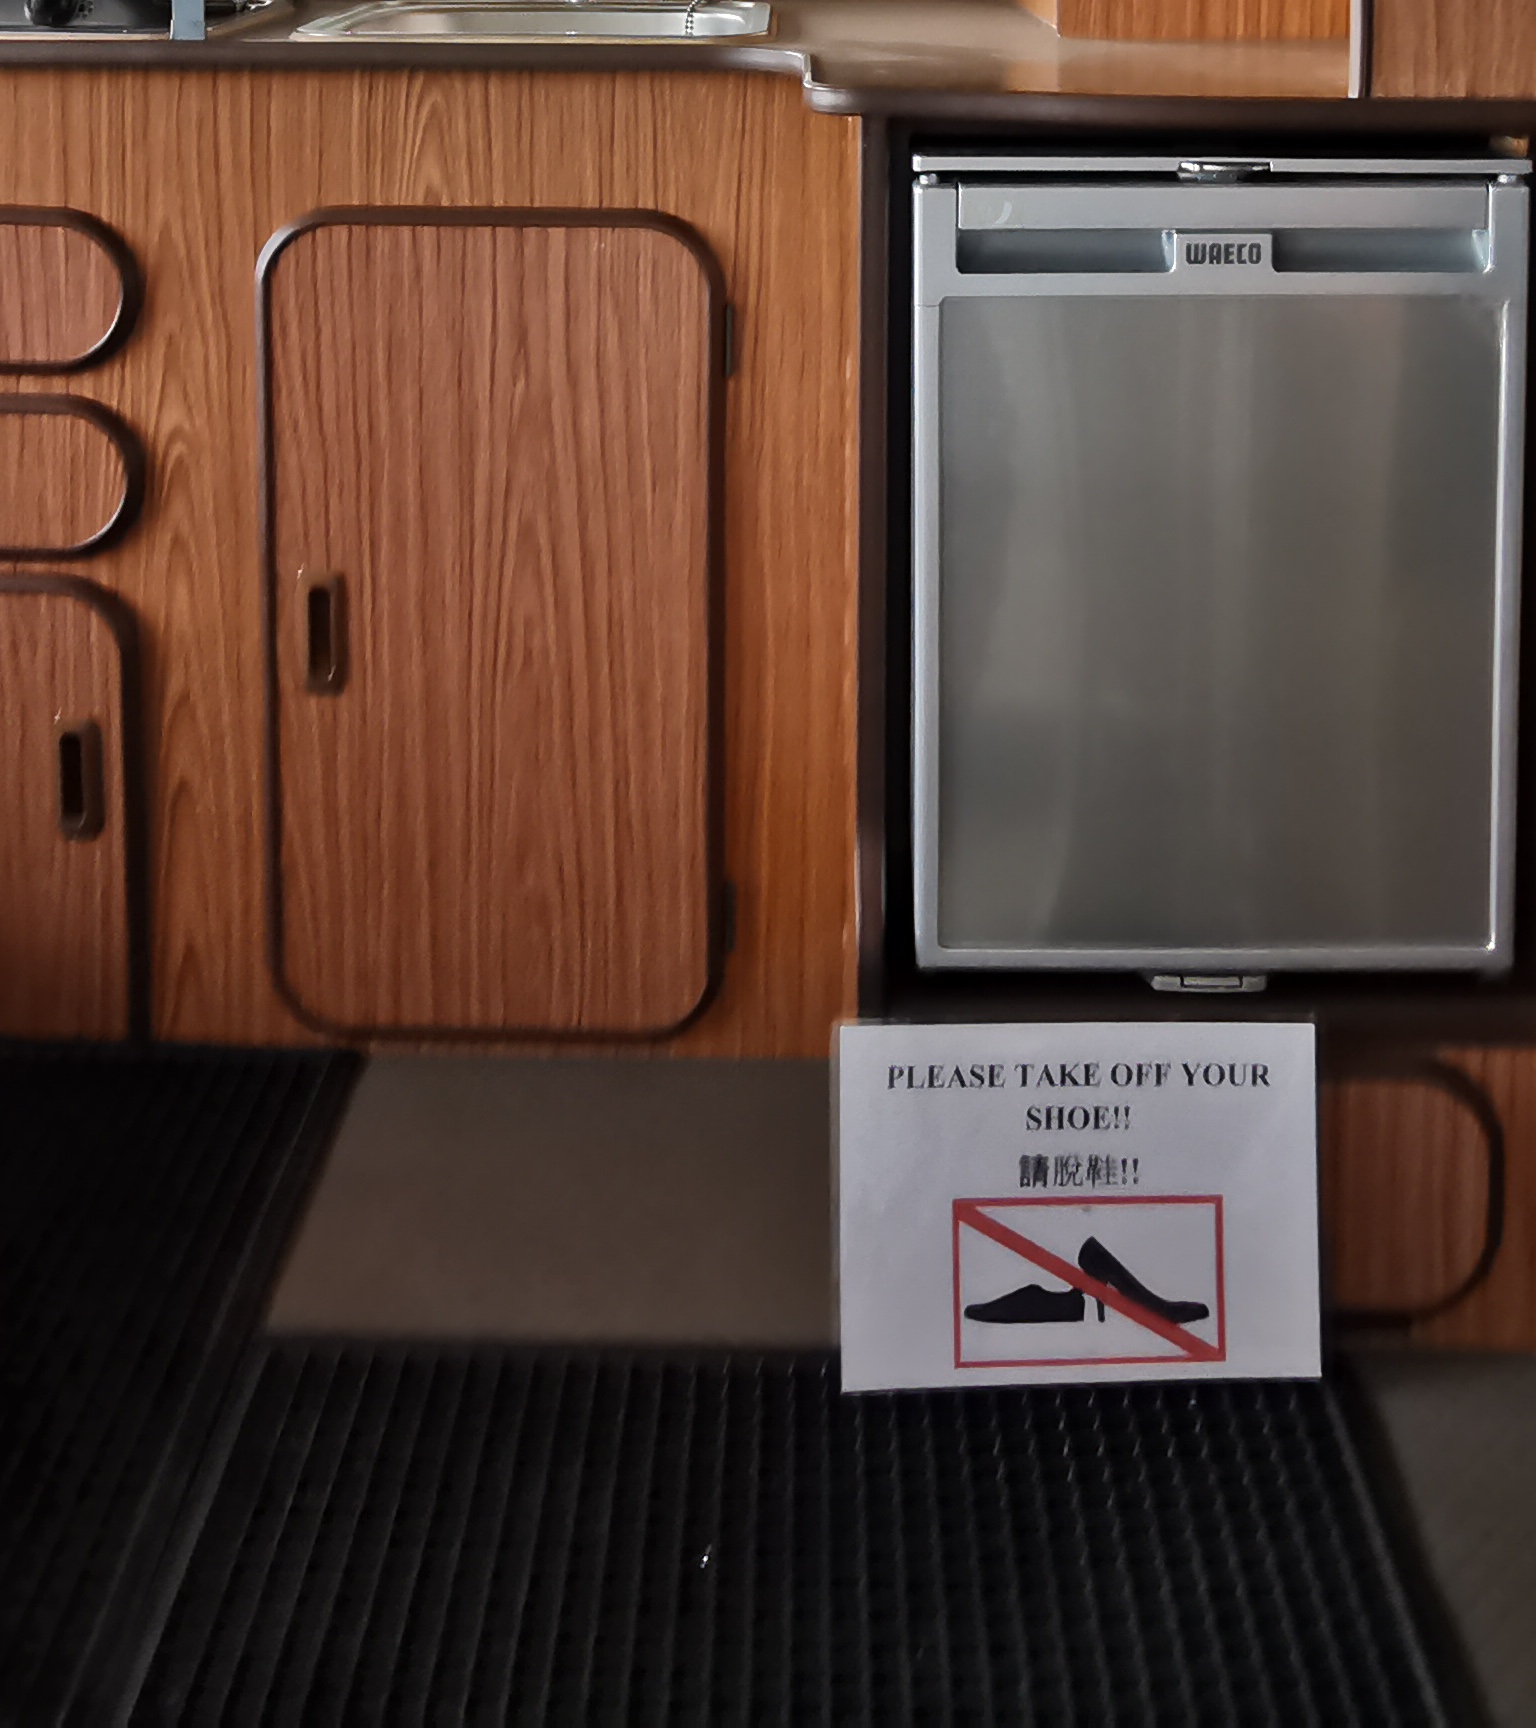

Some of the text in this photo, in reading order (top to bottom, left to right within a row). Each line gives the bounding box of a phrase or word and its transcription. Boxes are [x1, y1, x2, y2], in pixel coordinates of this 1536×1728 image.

[1185, 242, 1262, 265] WAECO
[887, 1061, 1271, 1090] PLEASE TAKE OFF YOUR
[1025, 1104, 1131, 1132] SHOE!!
